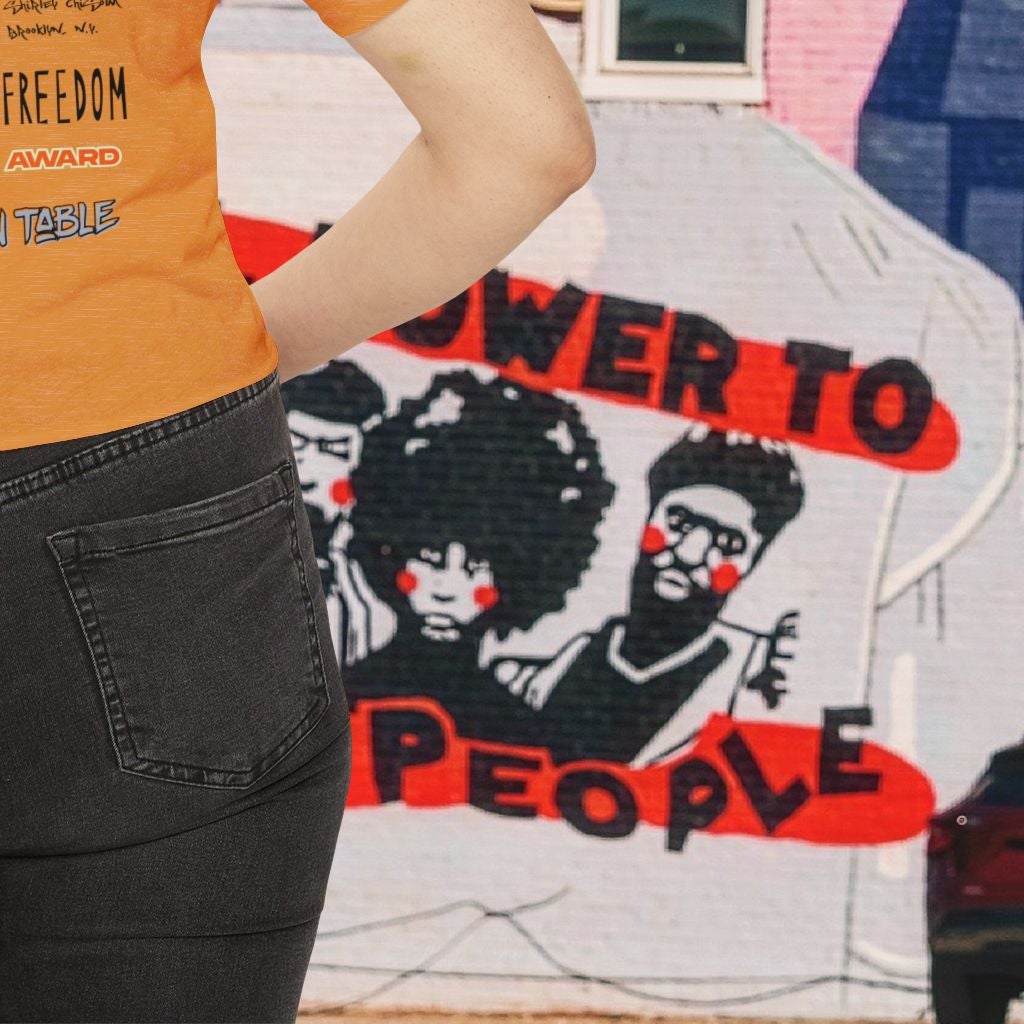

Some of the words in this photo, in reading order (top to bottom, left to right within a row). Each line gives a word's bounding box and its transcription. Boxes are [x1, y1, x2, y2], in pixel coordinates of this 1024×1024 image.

[3, 66, 127, 125] FREEDOM
[3, 145, 122, 172] AWARD
[13, 199, 120, 245] TABLE
[784, 339, 934, 454] TO
[370, 706, 883, 853] PEOPLE
